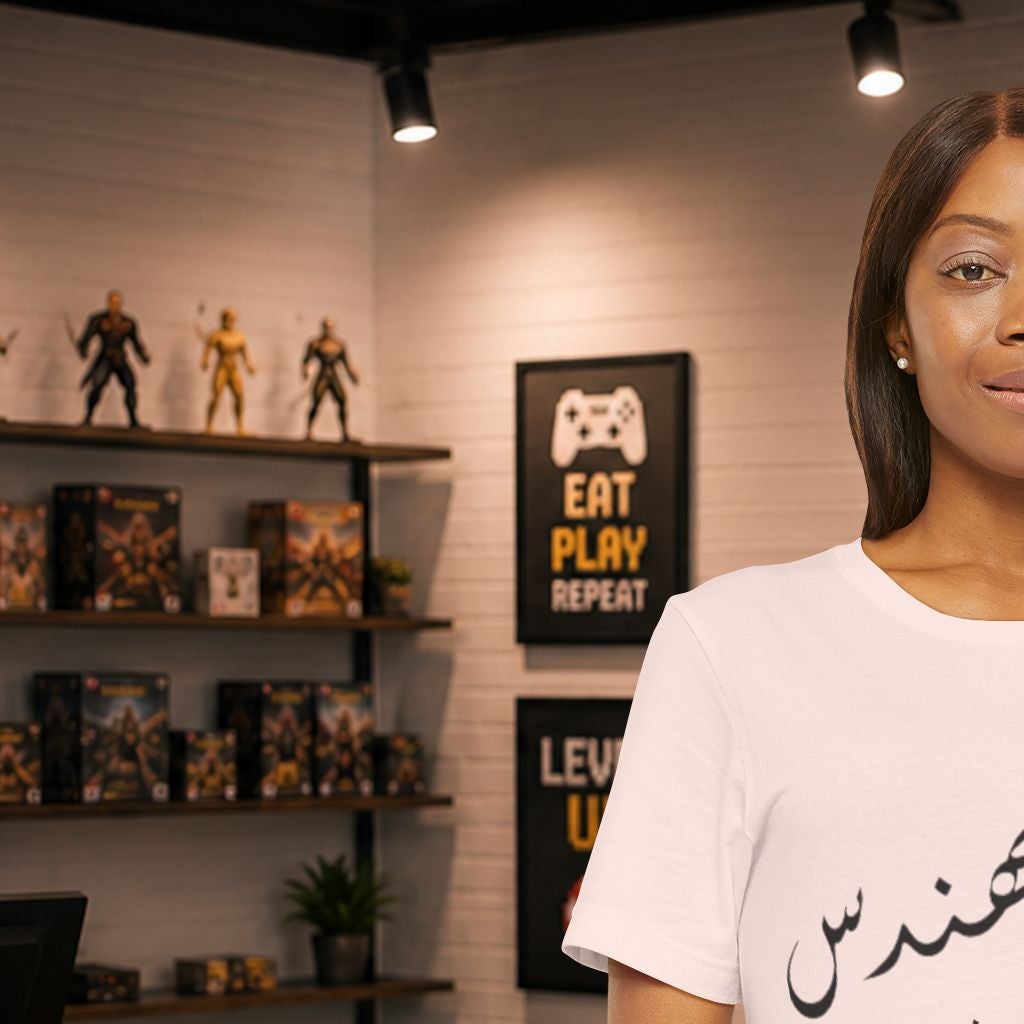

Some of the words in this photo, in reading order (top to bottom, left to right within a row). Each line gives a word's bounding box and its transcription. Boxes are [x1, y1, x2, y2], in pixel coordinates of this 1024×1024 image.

[564, 471, 637, 519] EAT
[551, 525, 648, 573] PLAY
[551, 578, 648, 612] REPEAT
[540, 736, 624, 788] LEV
[566, 793, 611, 850] U
